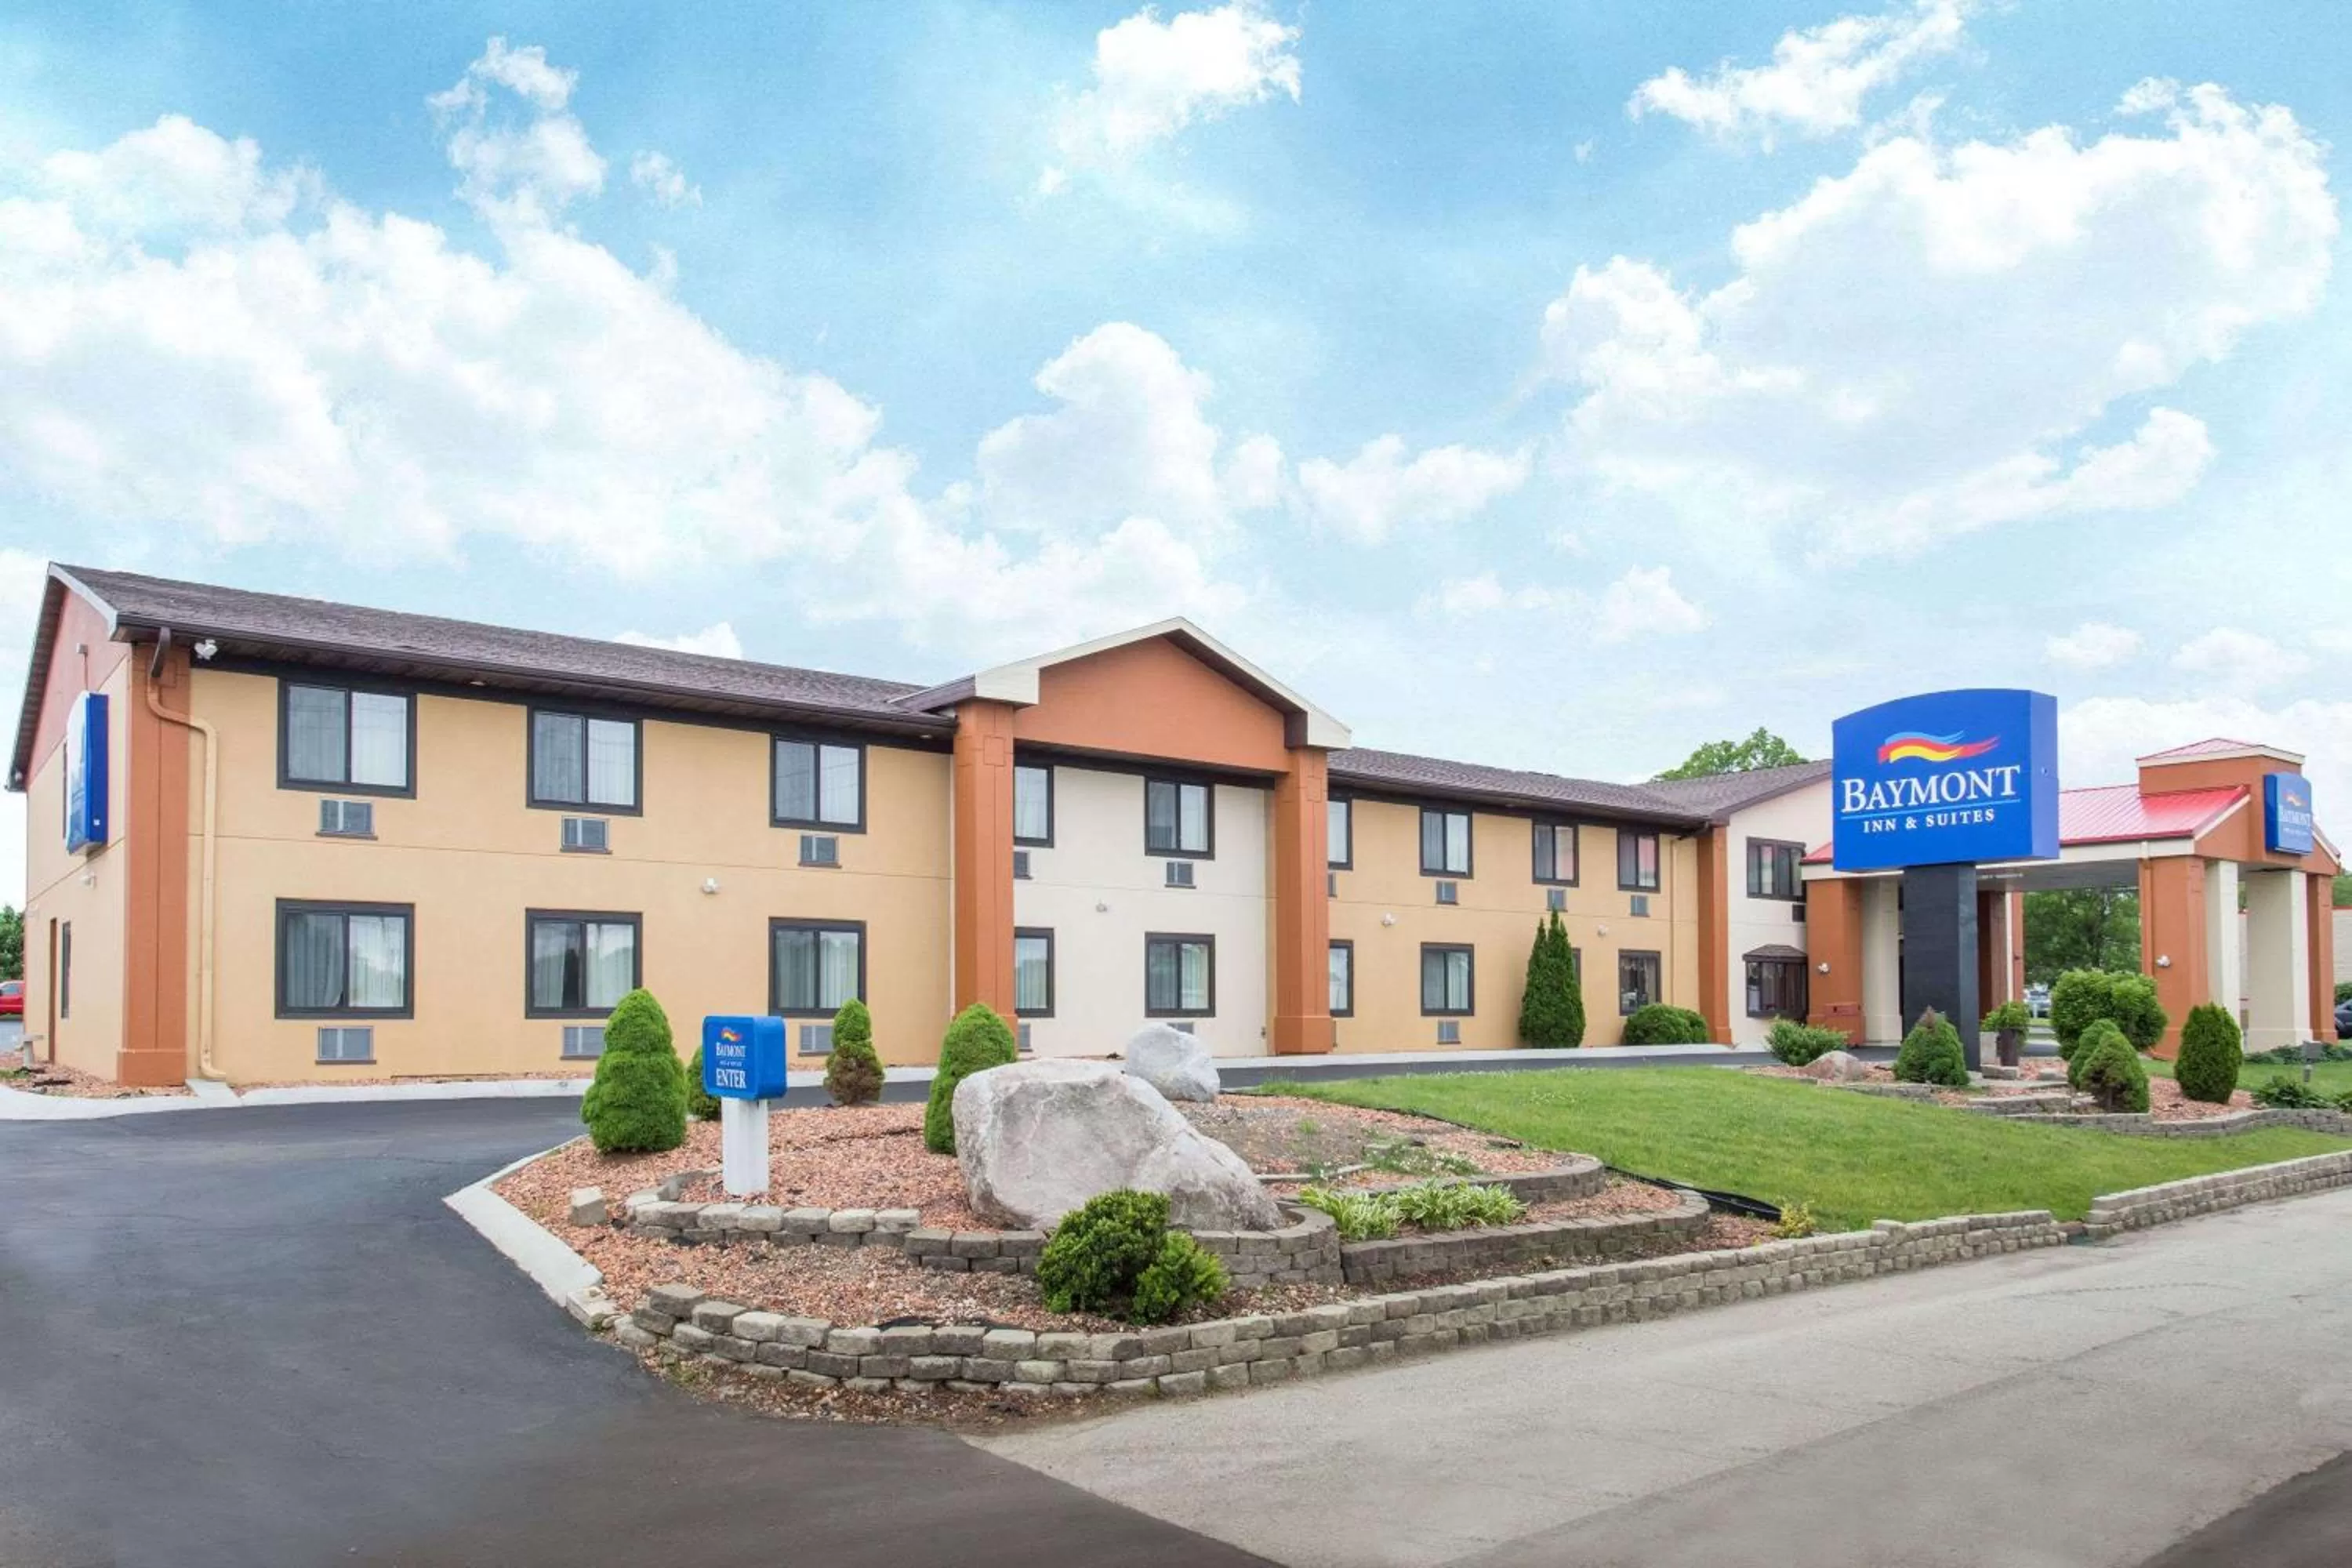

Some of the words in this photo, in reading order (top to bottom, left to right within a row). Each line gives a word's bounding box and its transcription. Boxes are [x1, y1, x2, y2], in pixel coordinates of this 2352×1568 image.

[1841, 765, 2020, 812] BAYMONT
[1864, 819, 1897, 833] INN
[1905, 815, 1918, 829] &
[1926, 808, 1995, 827] SUITES
[716, 1069, 746, 1088] ENTER
